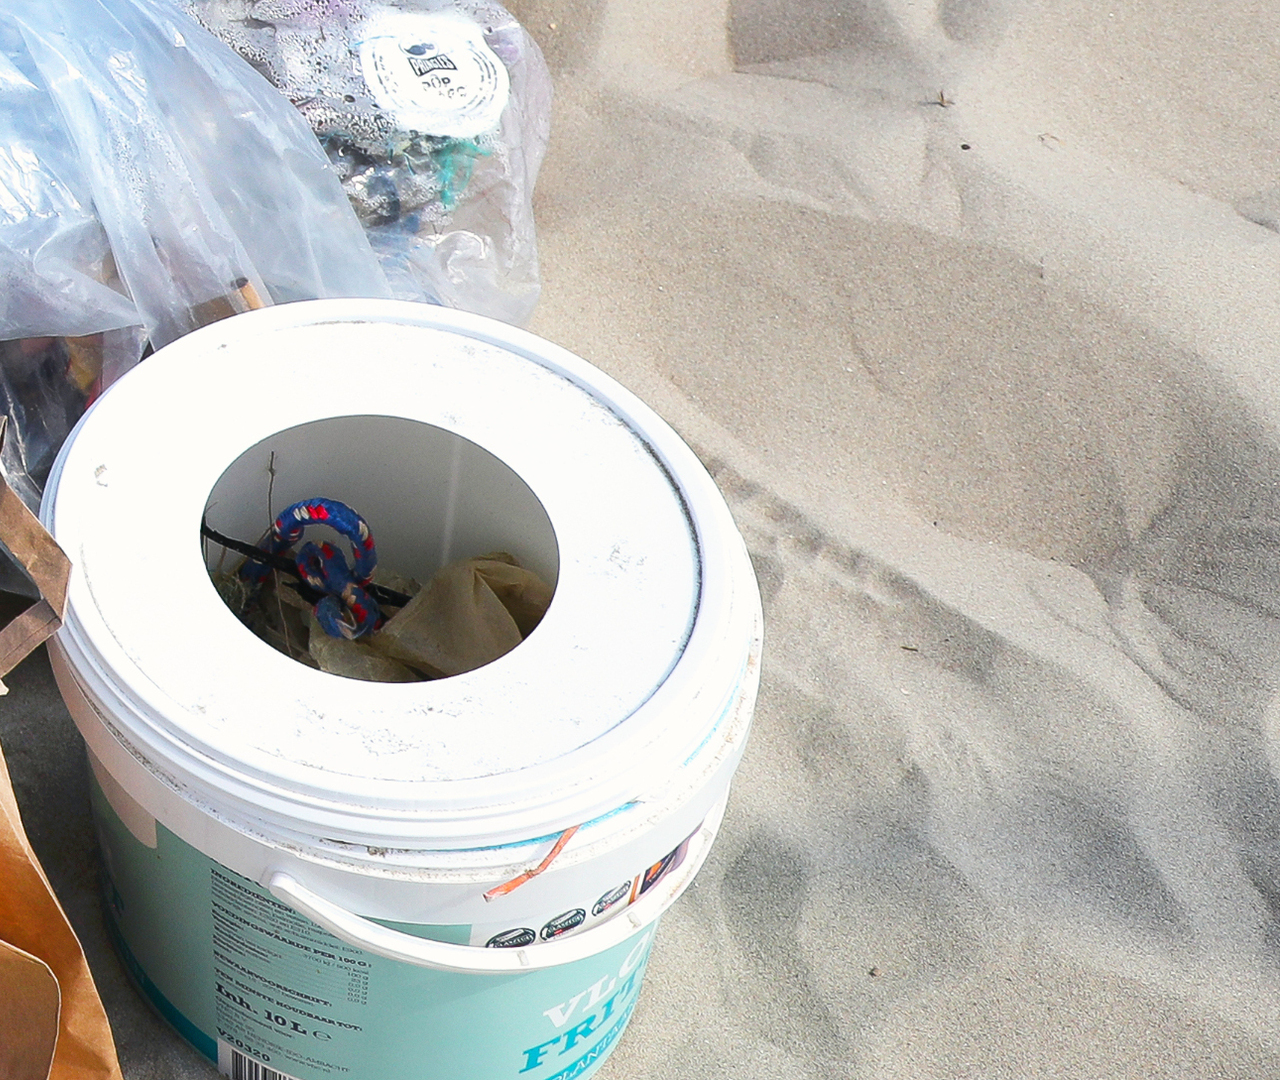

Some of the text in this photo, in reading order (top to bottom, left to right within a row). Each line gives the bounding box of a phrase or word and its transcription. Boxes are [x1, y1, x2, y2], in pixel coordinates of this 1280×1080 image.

[410, 54, 455, 77] PRINGLES
[211, 900, 312, 951] VOEDINGSWAARDE
[313, 948, 336, 960] PER
[215, 981, 258, 1015] Inh.
[265, 1009, 287, 1027] 10
[290, 1021, 307, 1036] L
[216, 1026, 270, 1062] V20320
